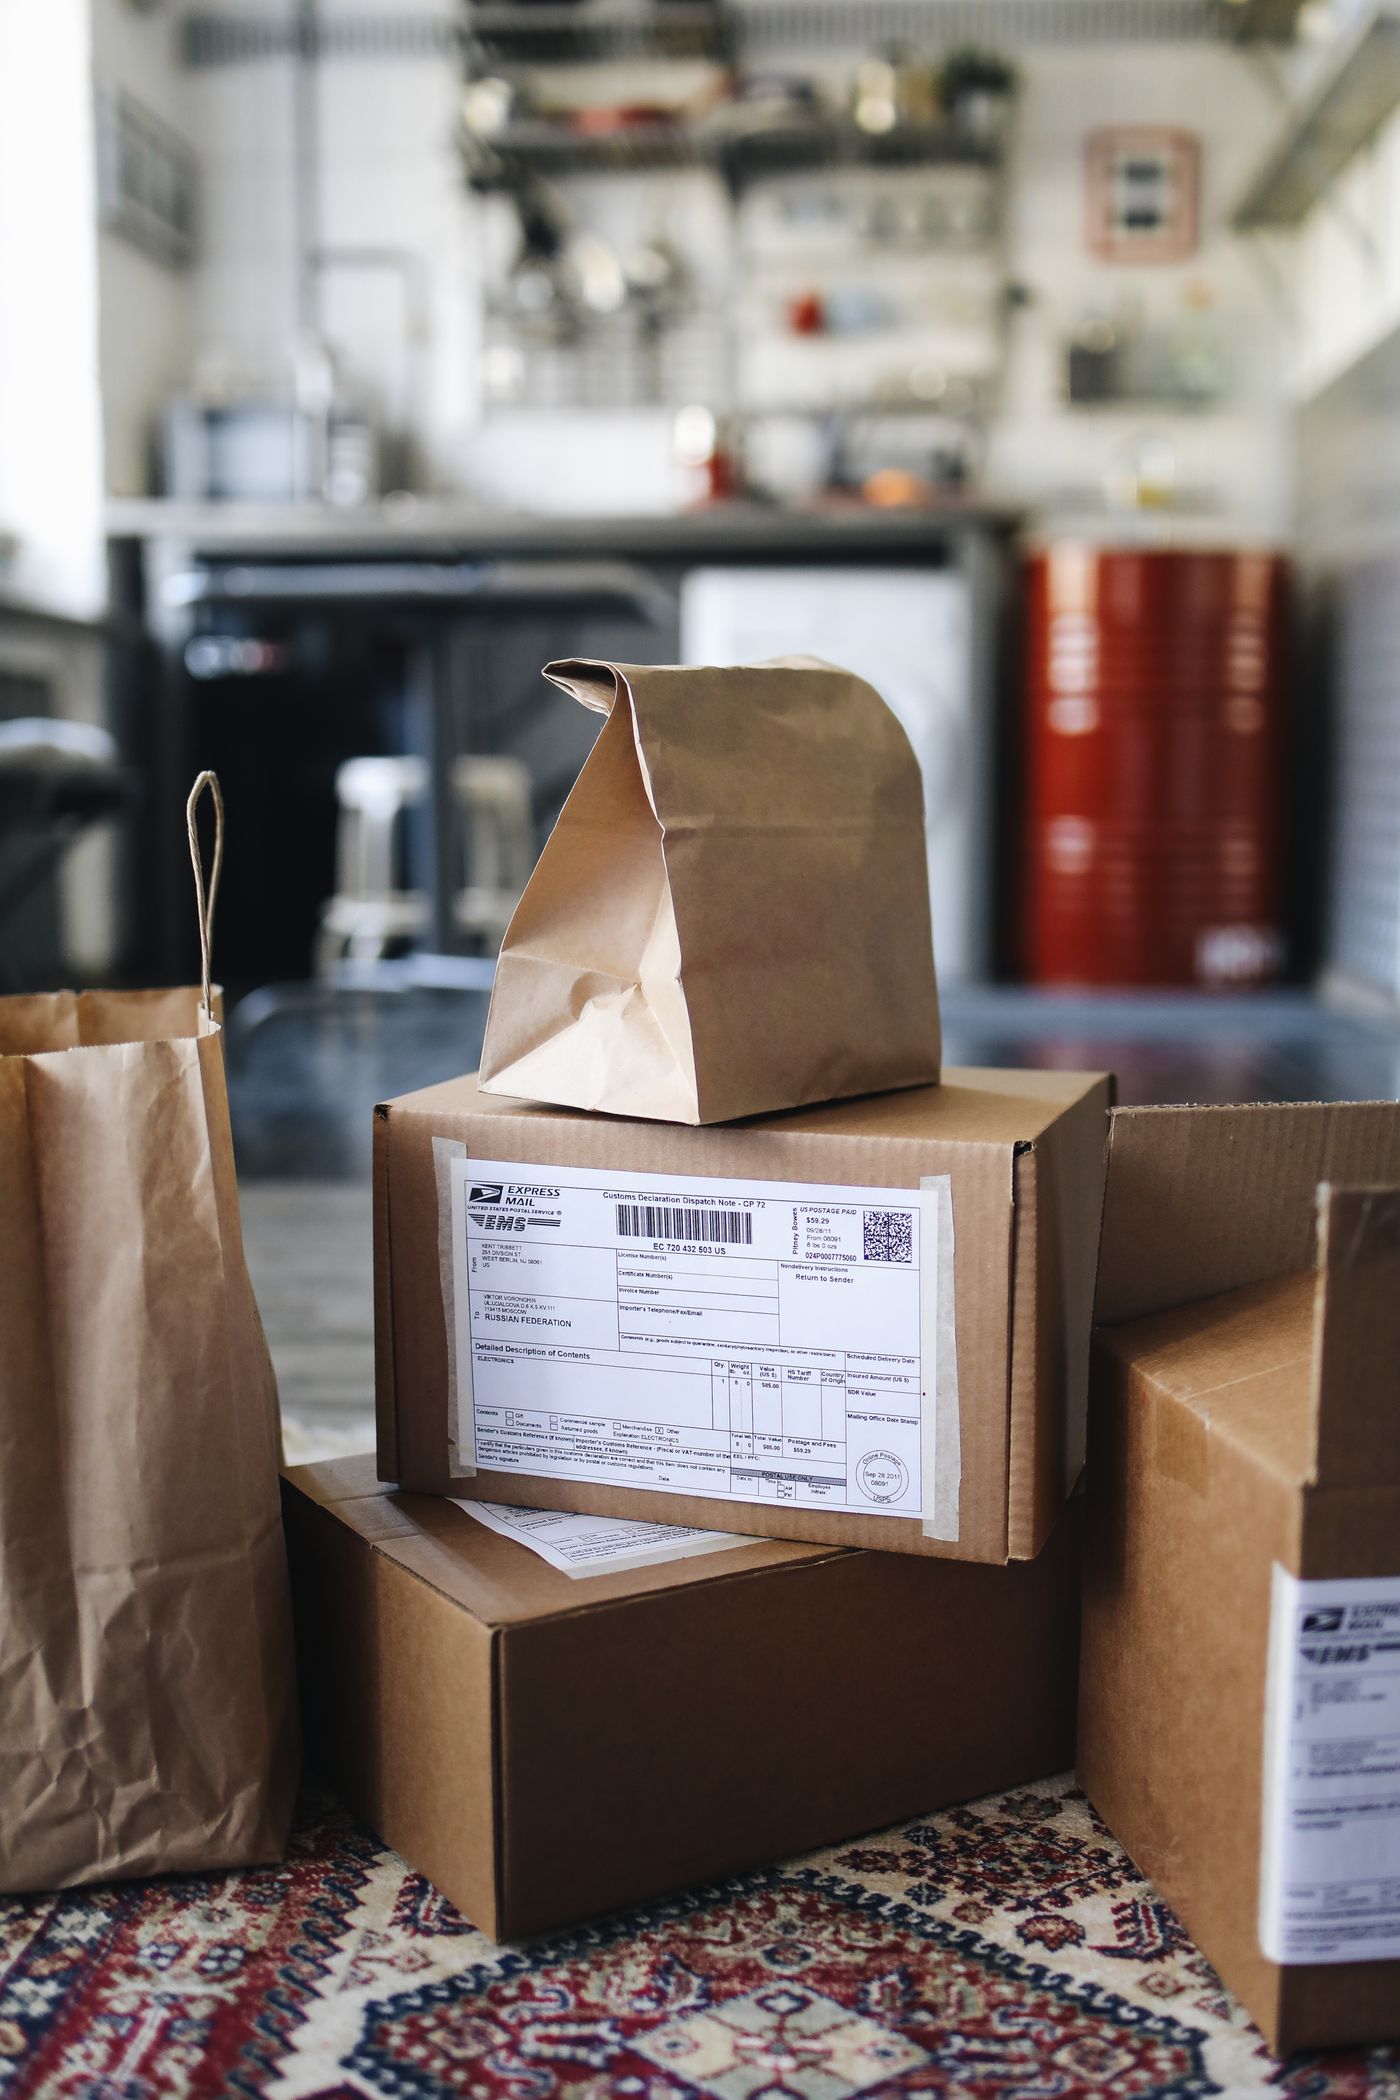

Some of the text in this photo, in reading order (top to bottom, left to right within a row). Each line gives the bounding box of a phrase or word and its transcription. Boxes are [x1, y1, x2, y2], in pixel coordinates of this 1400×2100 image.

[507, 1185, 560, 1196] EXPRESS
[505, 1197, 535, 1206] MAIL
[602, 1192, 636, 1200] Customs
[638, 1195, 680, 1203] Declaration
[682, 1197, 716, 1207] Dispatch
[484, 1214, 527, 1232] EMS
[806, 1216, 829, 1224] $59.29
[667, 1243, 680, 1251] 720
[791, 1232, 799, 1255] Pitney
[639, 1253, 666, 1261] Number(s)
[780, 1263, 814, 1271] Nondelivery
[645, 1272, 672, 1280] Number(s)
[795, 1273, 819, 1281] Return
[828, 1275, 854, 1283] Sender
[484, 1312, 572, 1327] RUSSIAN FEDERATION
[475, 1342, 589, 1359] Detailed Description of Contents
[477, 1355, 514, 1364] ELECTRONICS
[515, 1420, 541, 1428] Documents
[787, 1438, 809, 1446] Postage
